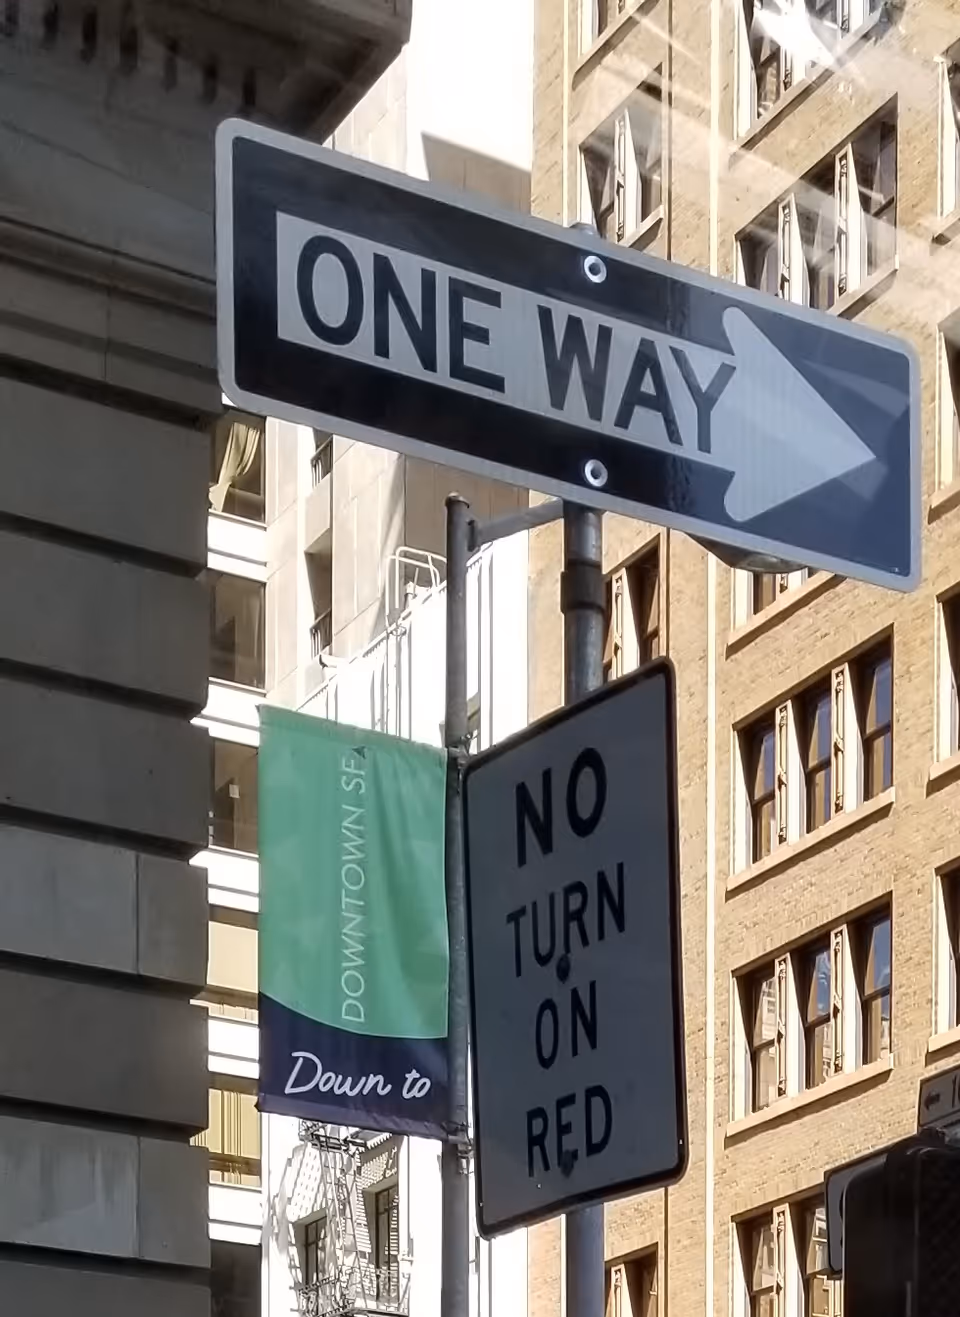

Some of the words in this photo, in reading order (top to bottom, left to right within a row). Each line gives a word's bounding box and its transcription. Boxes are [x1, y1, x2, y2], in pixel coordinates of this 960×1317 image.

[297, 235, 506, 394] ONE
[537, 304, 737, 454] WAY
[341, 758, 366, 796] SF
[515, 747, 608, 869] NO
[341, 807, 366, 1024] DOWNTOWN
[506, 862, 627, 978] TURN
[284, 1051, 391, 1098] Down
[402, 1068, 432, 1099] to
[535, 981, 599, 1070] ON
[526, 1084, 614, 1178] RED
